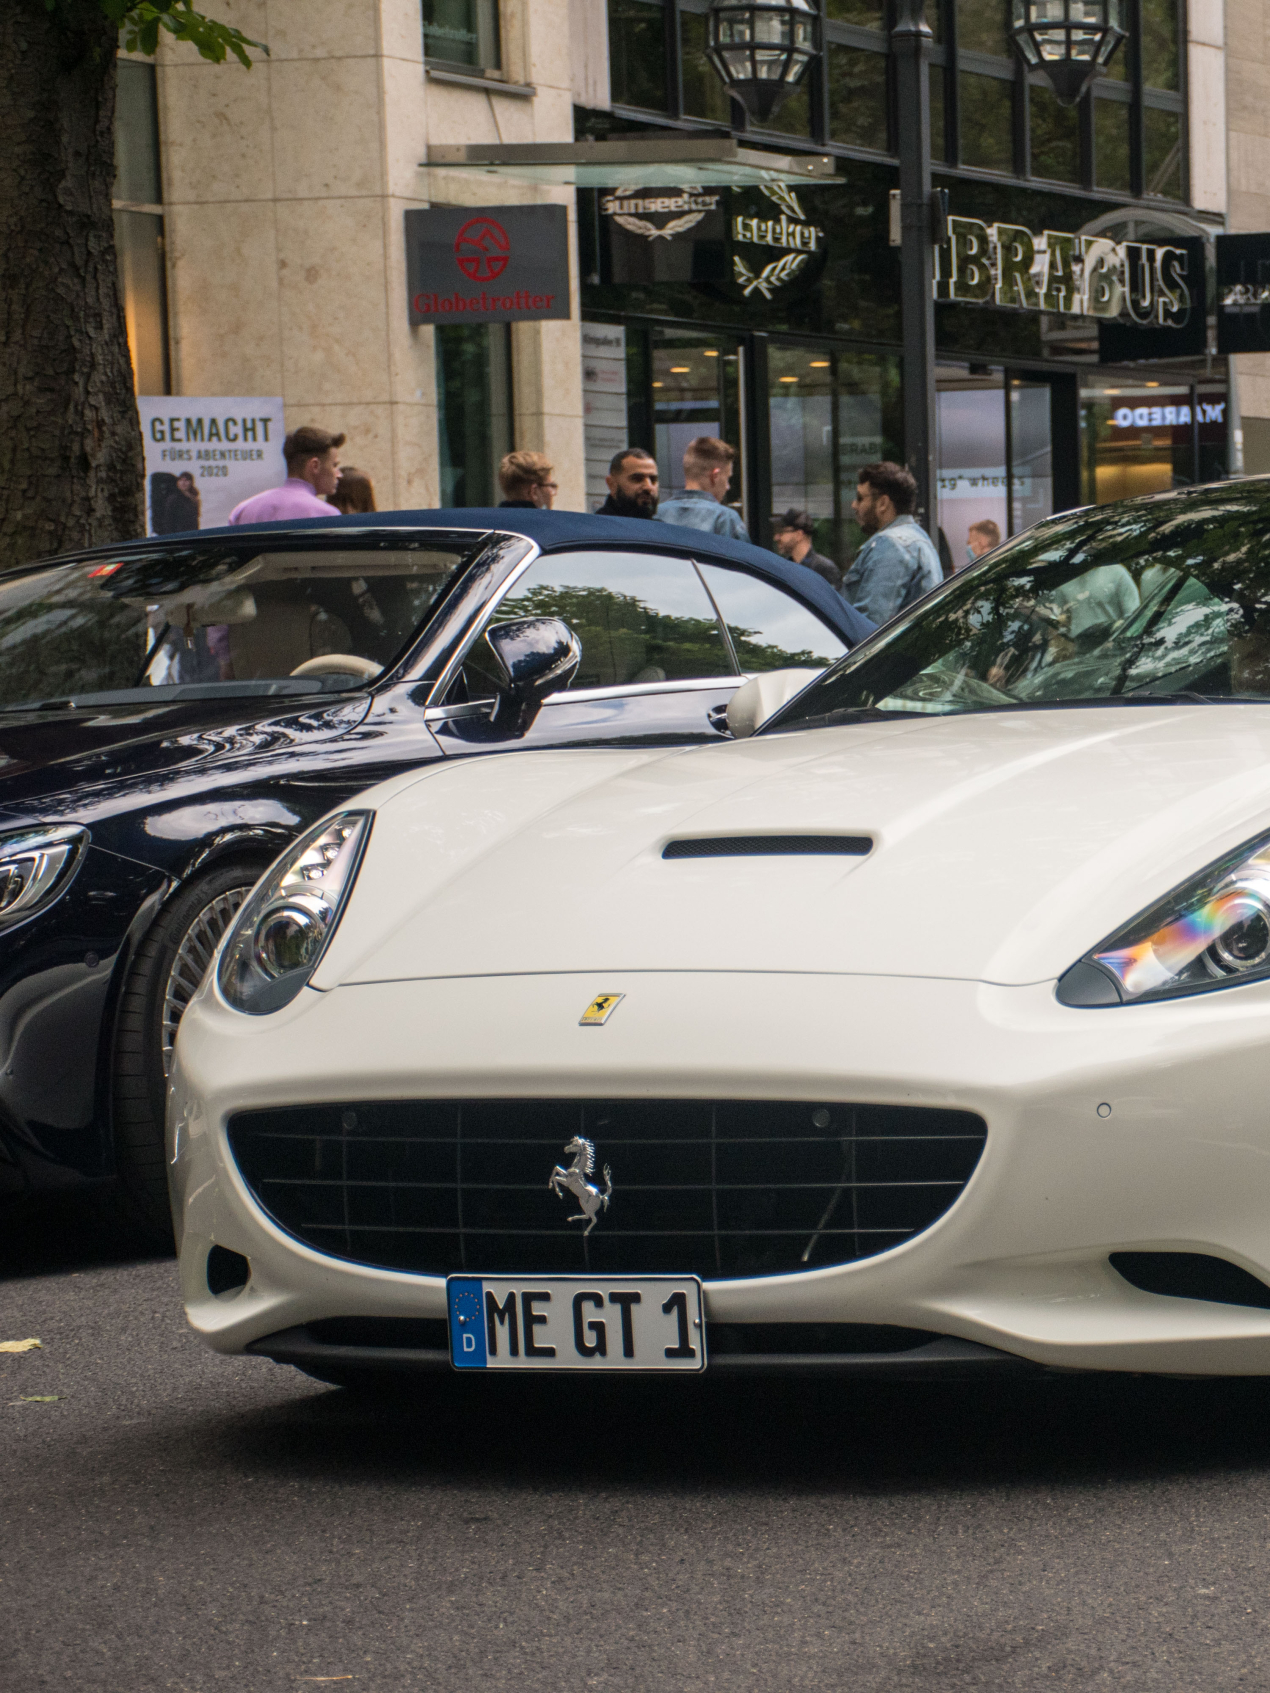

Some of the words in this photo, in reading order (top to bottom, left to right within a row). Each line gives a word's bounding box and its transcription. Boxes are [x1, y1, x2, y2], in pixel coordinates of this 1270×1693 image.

[601, 192, 721, 215] Sunseeker
[944, 215, 1191, 329] BRABUS
[413, 289, 556, 314] Globetrotter
[150, 417, 272, 443] GEMACHT
[161, 447, 193, 461] FÜRS
[195, 449, 264, 461] ABENTEUER
[199, 465, 229, 478] 2020
[485, 1290, 557, 1357] ME
[572, 1290, 642, 1358] GT
[662, 1291, 697, 1358] 1
[462, 1333, 476, 1352] D
